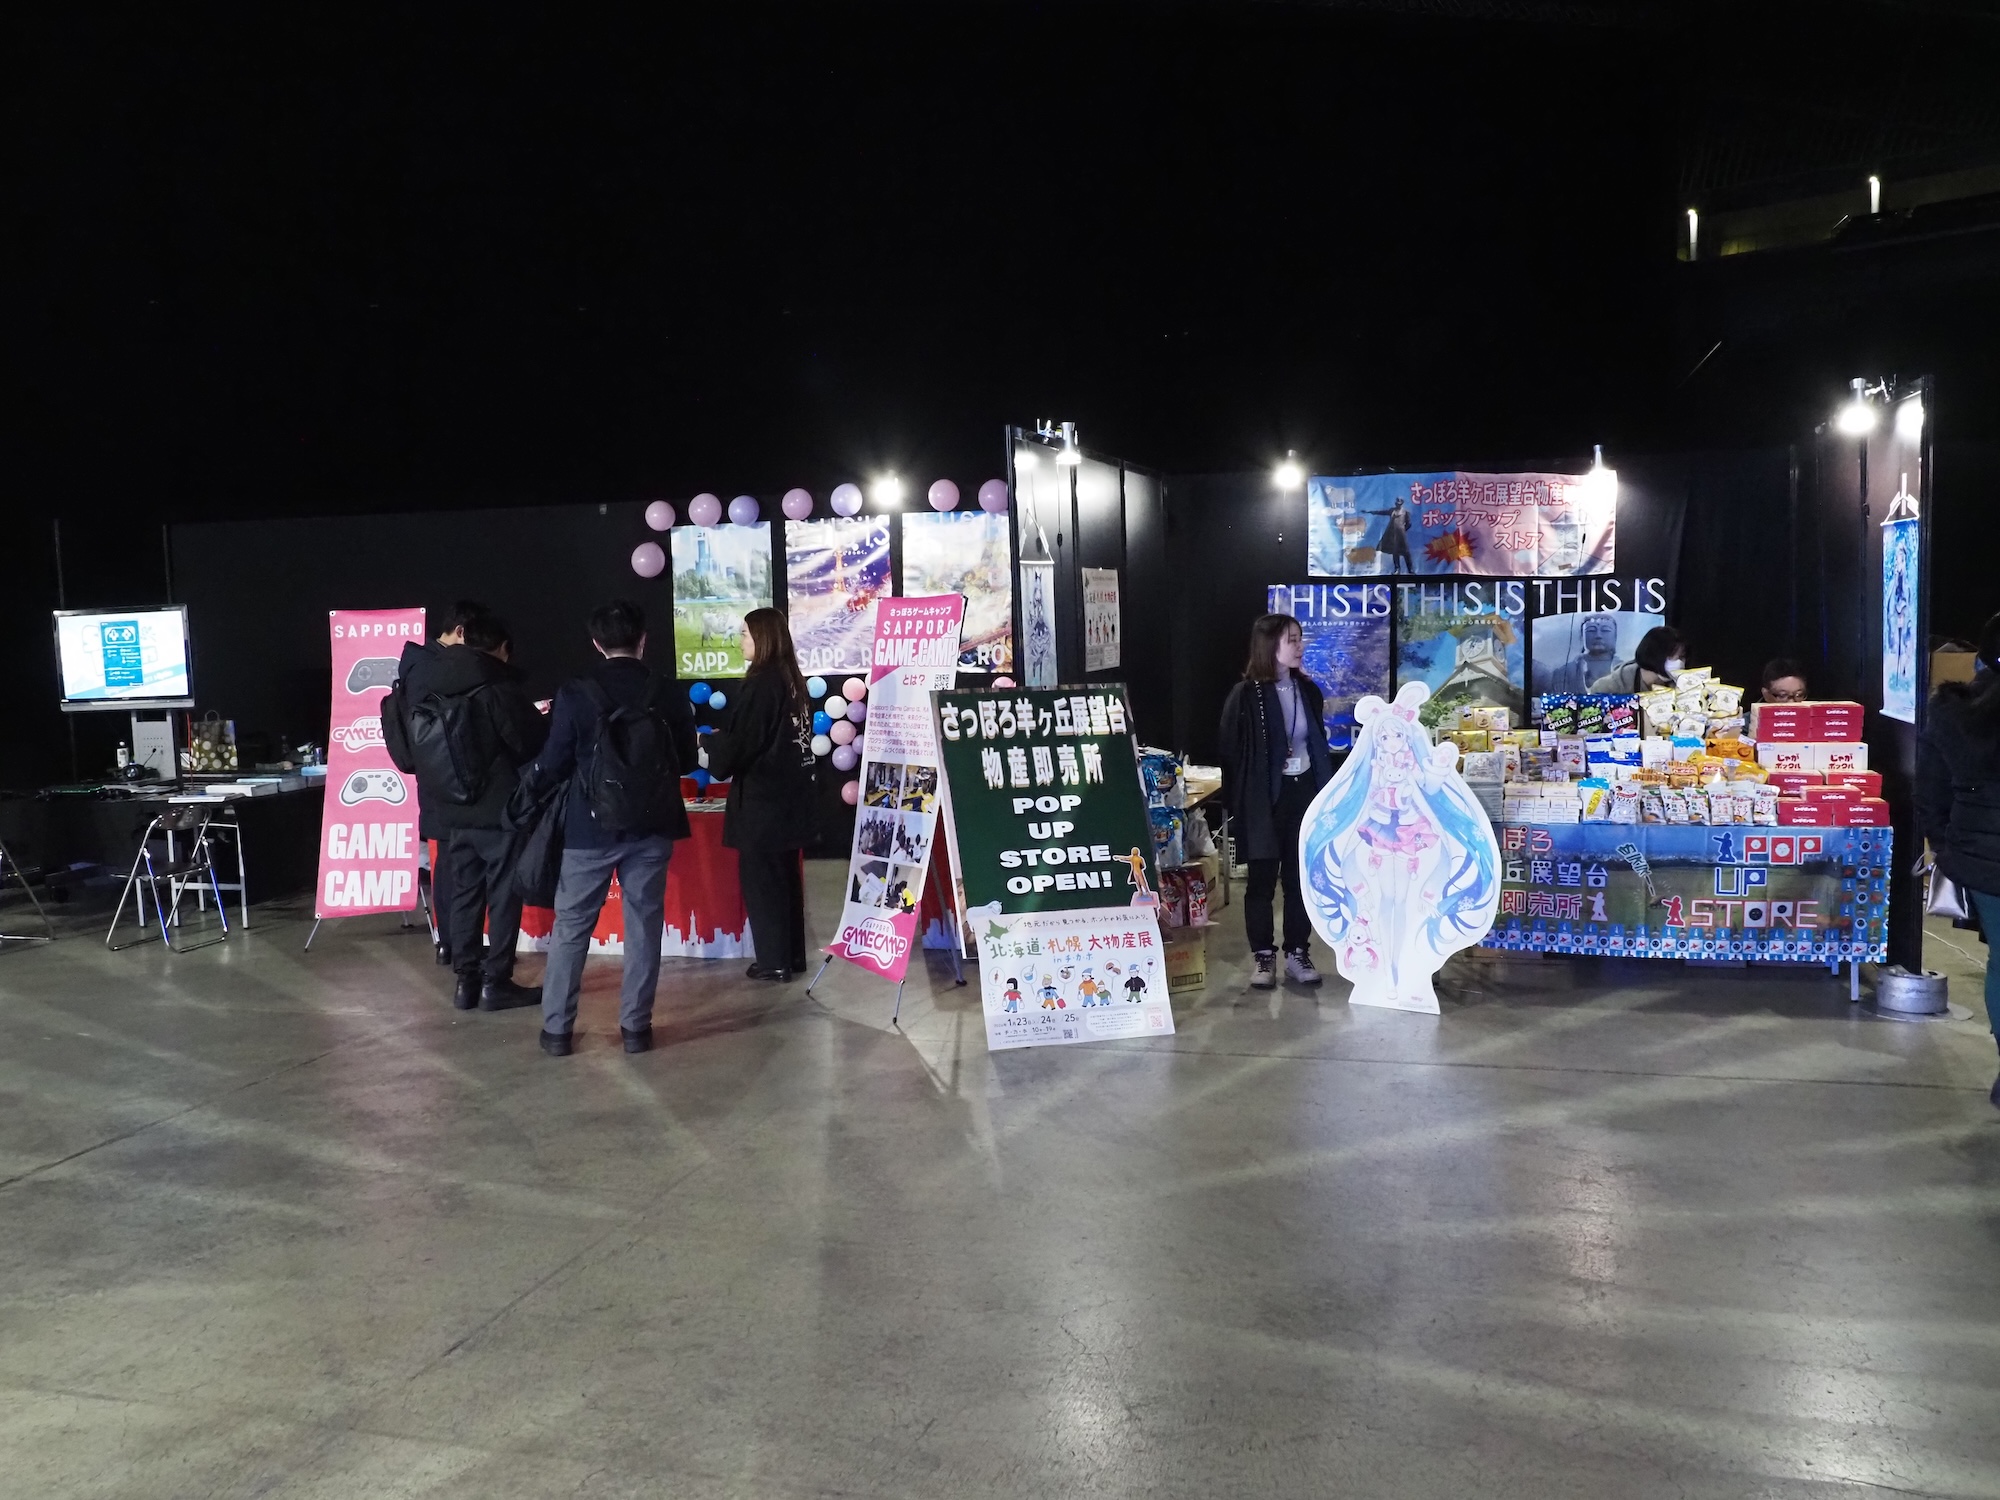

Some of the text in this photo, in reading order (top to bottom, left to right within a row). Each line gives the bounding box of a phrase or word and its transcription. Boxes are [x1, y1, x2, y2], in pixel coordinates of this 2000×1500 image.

[1421, 509, 1521, 529] ポップアップ
[1492, 531, 1544, 551] ストア
[1361, 583, 1392, 618] IS
[1397, 581, 1526, 617] THIS IS
[1532, 577, 1667, 615] THIS IS
[889, 605, 952, 617] さっぽろゲームキャンプ
[335, 622, 423, 638] SAPPORO
[882, 618, 956, 636] SAPPORO
[874, 637, 958, 668] GAME CAMP
[981, 742, 1104, 790] 物産即売所
[1777, 752, 1800, 762] じゃが
[1830, 752, 1854, 762] じゃが
[1012, 794, 1082, 815] POP
[328, 822, 414, 859] GAME
[1028, 821, 1075, 840] UP
[999, 844, 1112, 868] STORE
[1743, 835, 1823, 865] POP
[324, 870, 412, 907] CAMP
[1006, 870, 1113, 895] OPEN!
[1714, 867, 1768, 897] UP
[1500, 889, 1584, 921] 即売所
[1690, 899, 1819, 928] STORE
[1088, 930, 1154, 951] 大物産展
